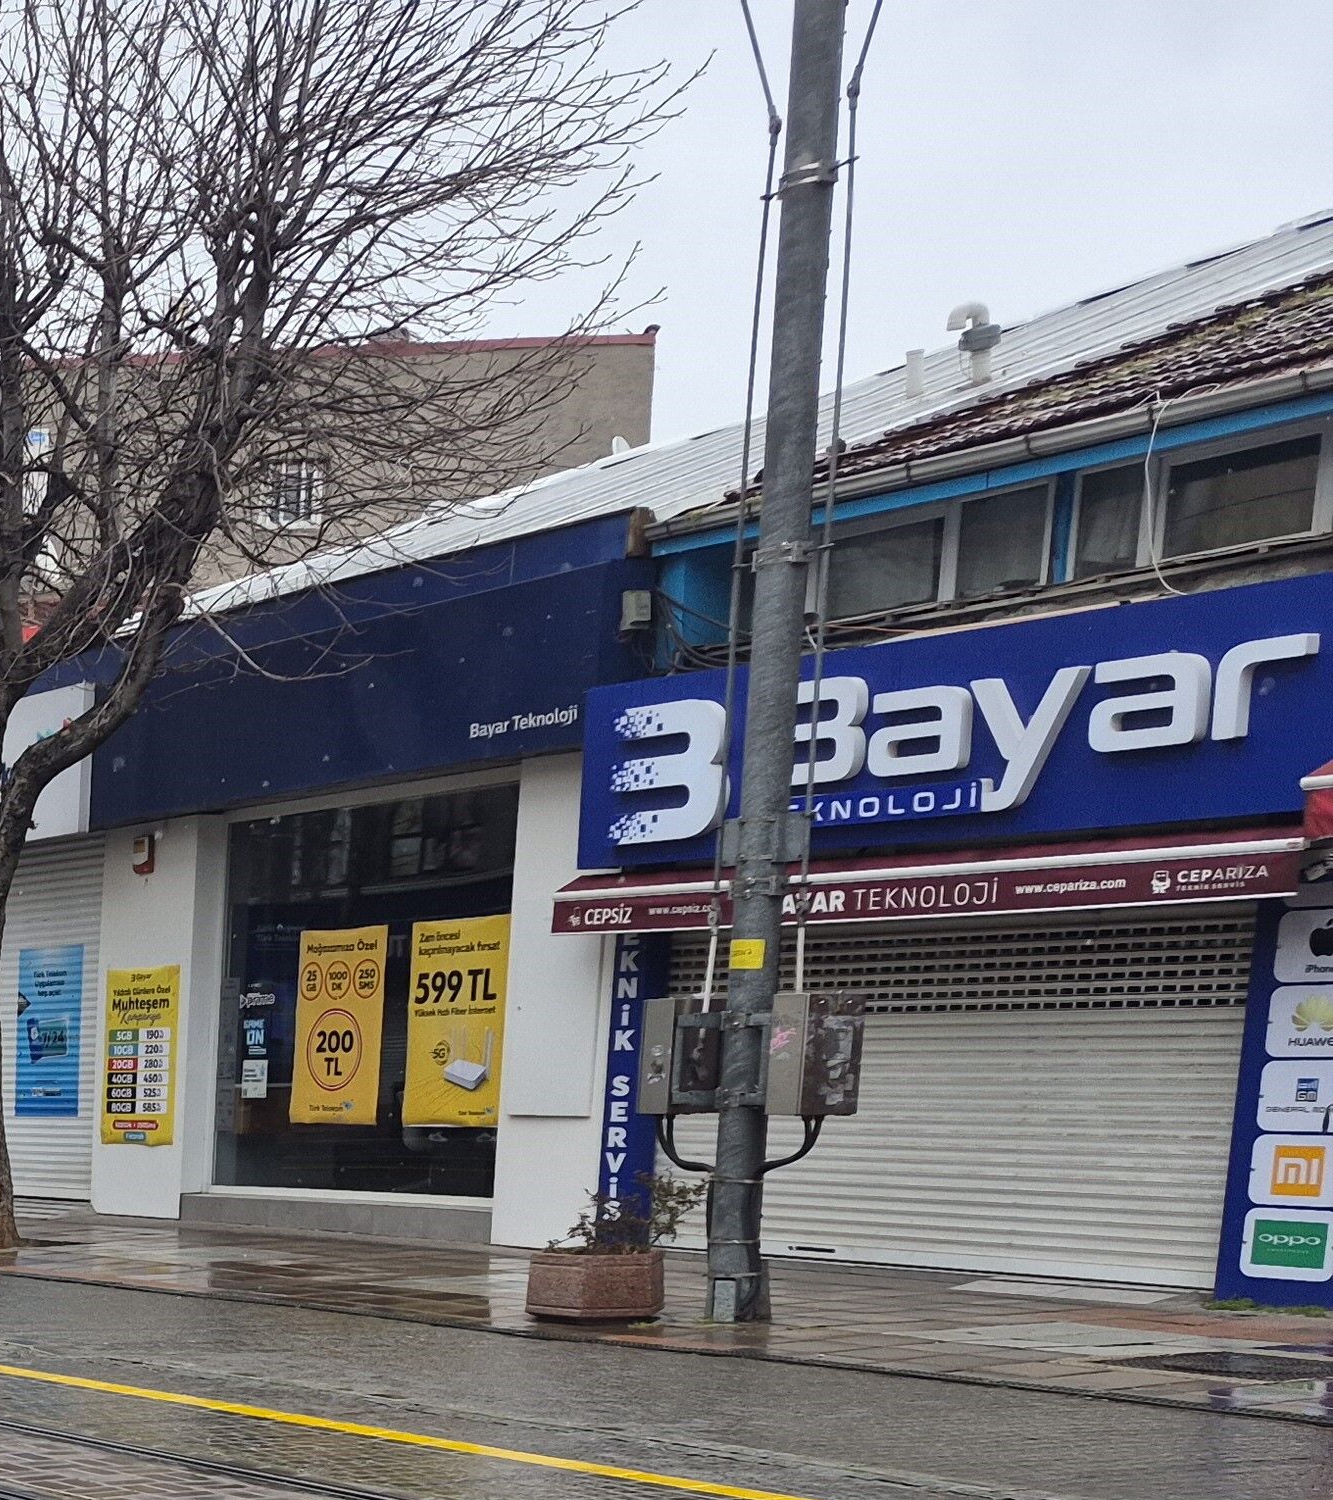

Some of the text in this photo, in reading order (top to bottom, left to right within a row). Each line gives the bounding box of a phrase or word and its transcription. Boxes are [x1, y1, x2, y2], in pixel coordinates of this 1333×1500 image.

[469, 704, 578, 739] Bayar Teknoloji
[790, 633, 1320, 813] Bayar
[1015, 878, 1126, 895] www.cepariza.com
[648, 902, 716, 916] www.cepsiz.co
[781, 889, 845, 915] AYAR
[584, 902, 632, 925] CEPSİZ
[357, 938, 378, 952] Özel
[306, 970, 318, 982] 25
[329, 971, 348, 981] 1000
[359, 968, 376, 979] 250
[414, 968, 497, 1004] 599 TL
[112, 997, 170, 1013] Muhteşem
[247, 1029, 265, 1046] ON
[316, 1029, 354, 1054] 200
[1288, 1036, 1333, 1047] HUAWE
[324, 1057, 343, 1076] TL
